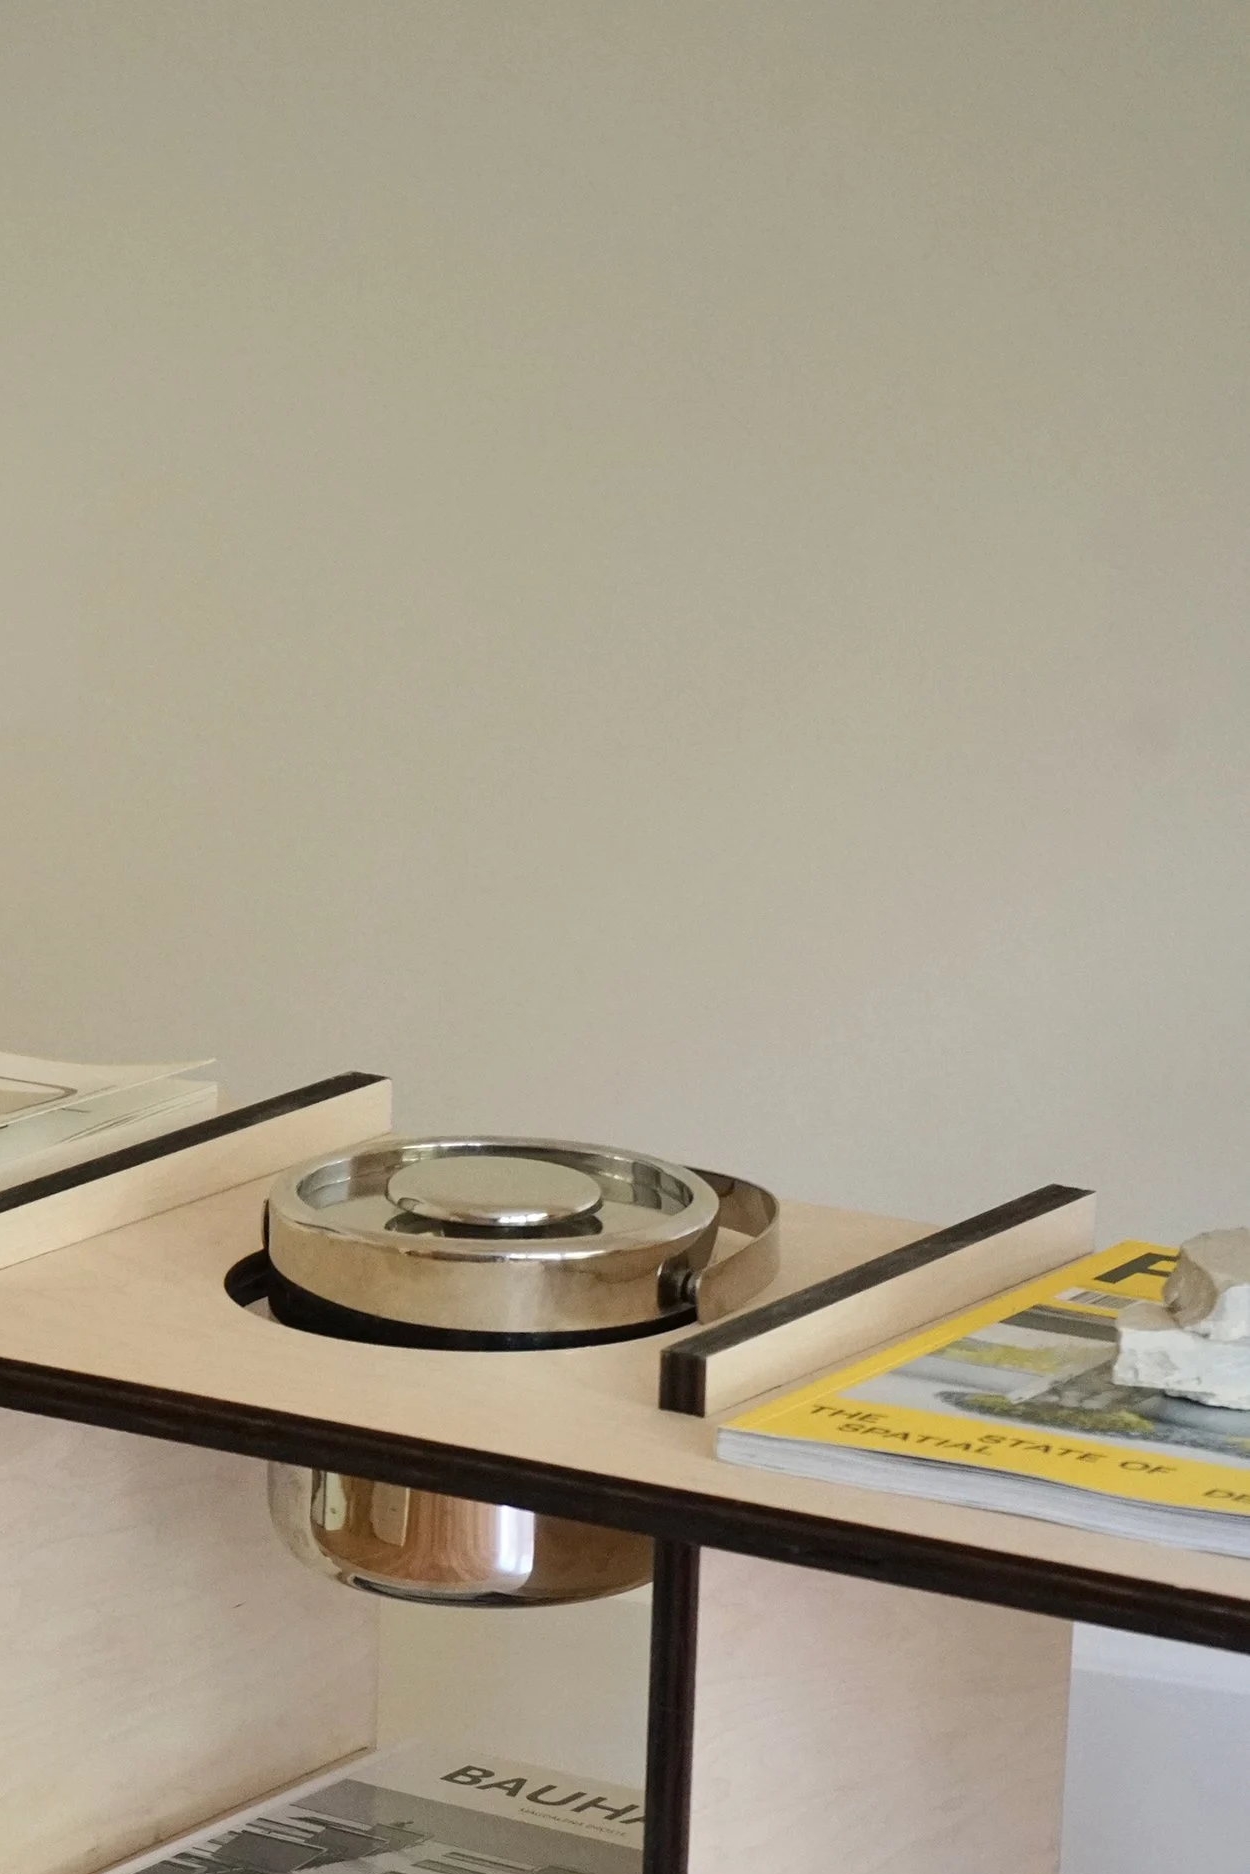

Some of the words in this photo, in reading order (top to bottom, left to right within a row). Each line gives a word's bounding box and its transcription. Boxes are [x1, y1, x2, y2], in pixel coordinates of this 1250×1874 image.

[810, 1404, 888, 1424] THE
[836, 1422, 993, 1457] SPATIAL
[977, 1433, 1108, 1464] STATE
[1118, 1460, 1178, 1475] OF
